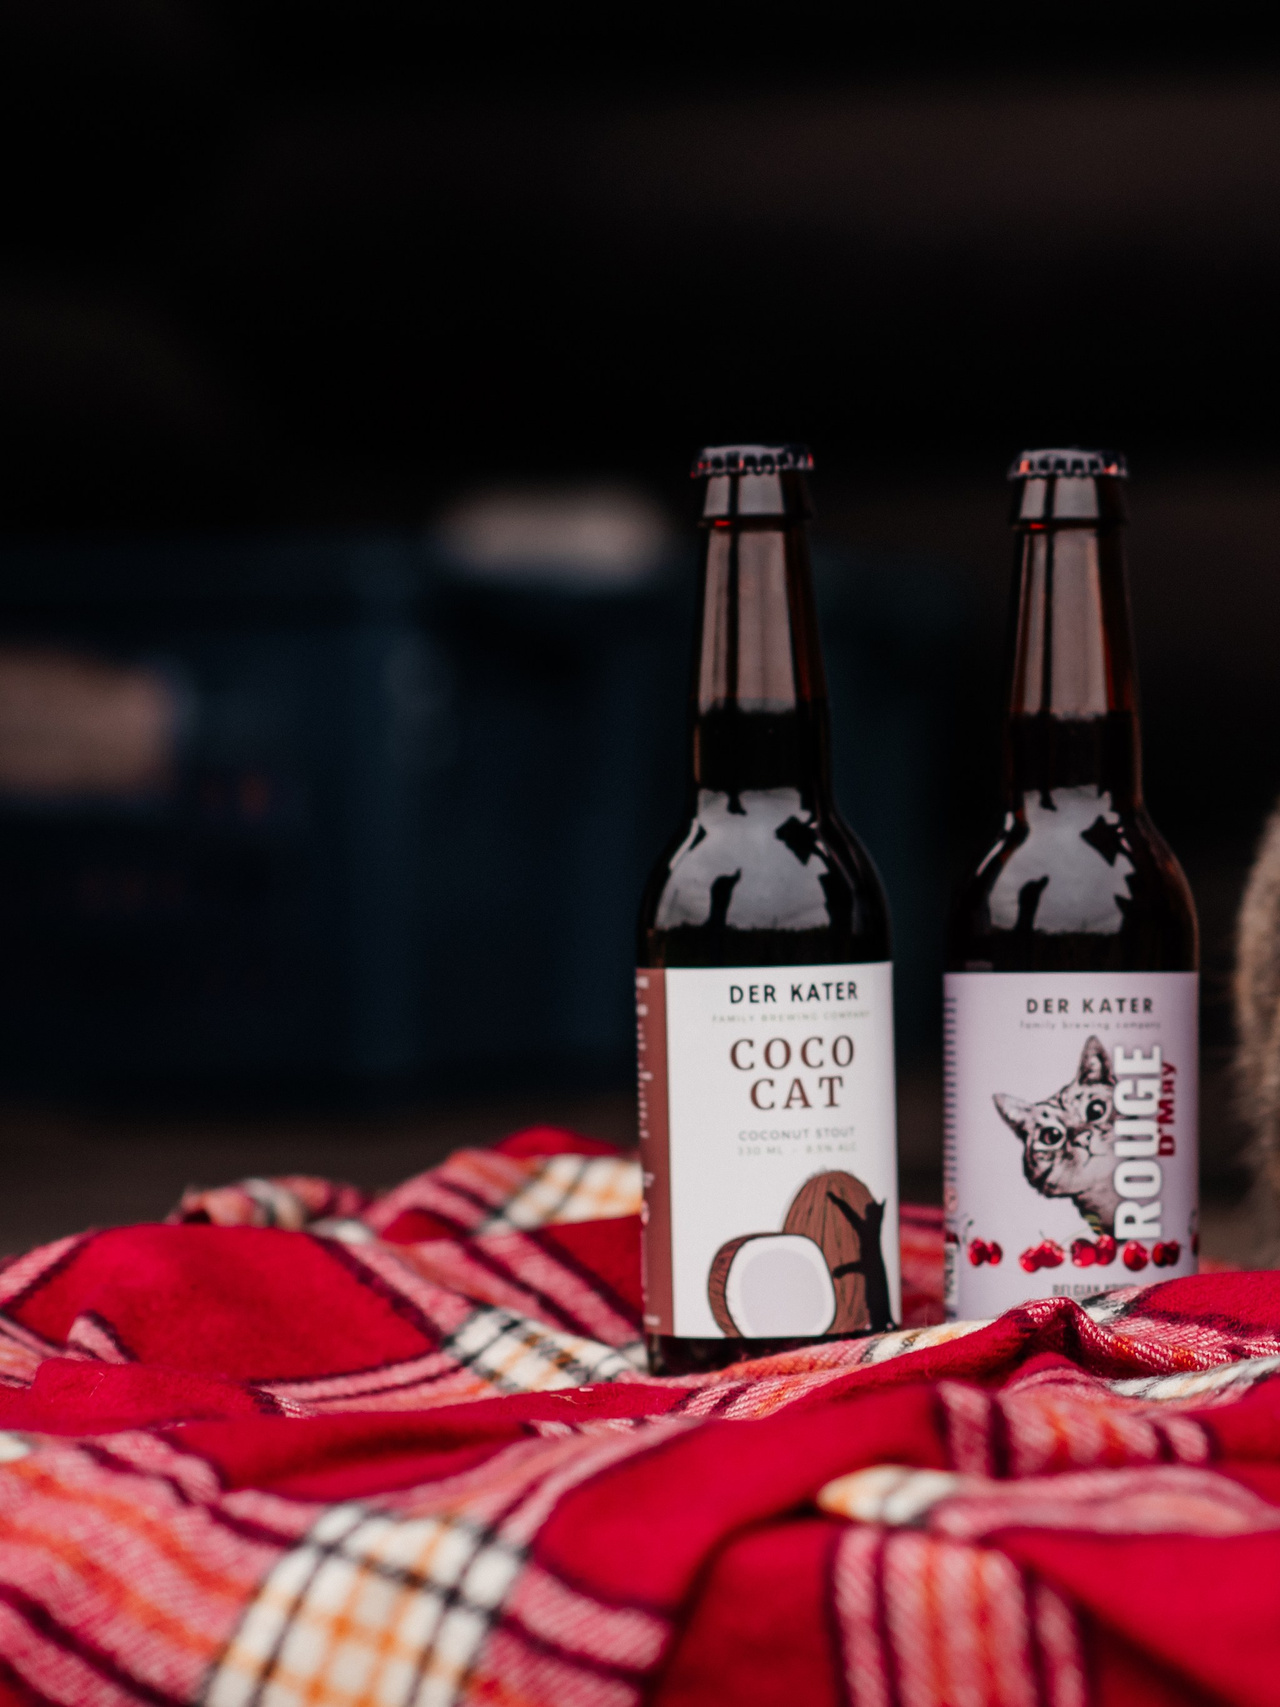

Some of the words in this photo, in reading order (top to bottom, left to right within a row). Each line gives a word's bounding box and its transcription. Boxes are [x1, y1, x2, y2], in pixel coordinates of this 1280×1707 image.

[729, 984, 777, 1004] DER
[790, 981, 858, 1002] KATER
[761, 1011, 818, 1023] BREWING
[1026, 999, 1069, 1014] DER
[1082, 998, 1154, 1014] KATER
[730, 1035, 855, 1071] COCO
[750, 1076, 843, 1111] CAT
[738, 1128, 808, 1142] COCONUT
[815, 1125, 855, 1140] STOUT
[1113, 1044, 1163, 1240] ROUGE
